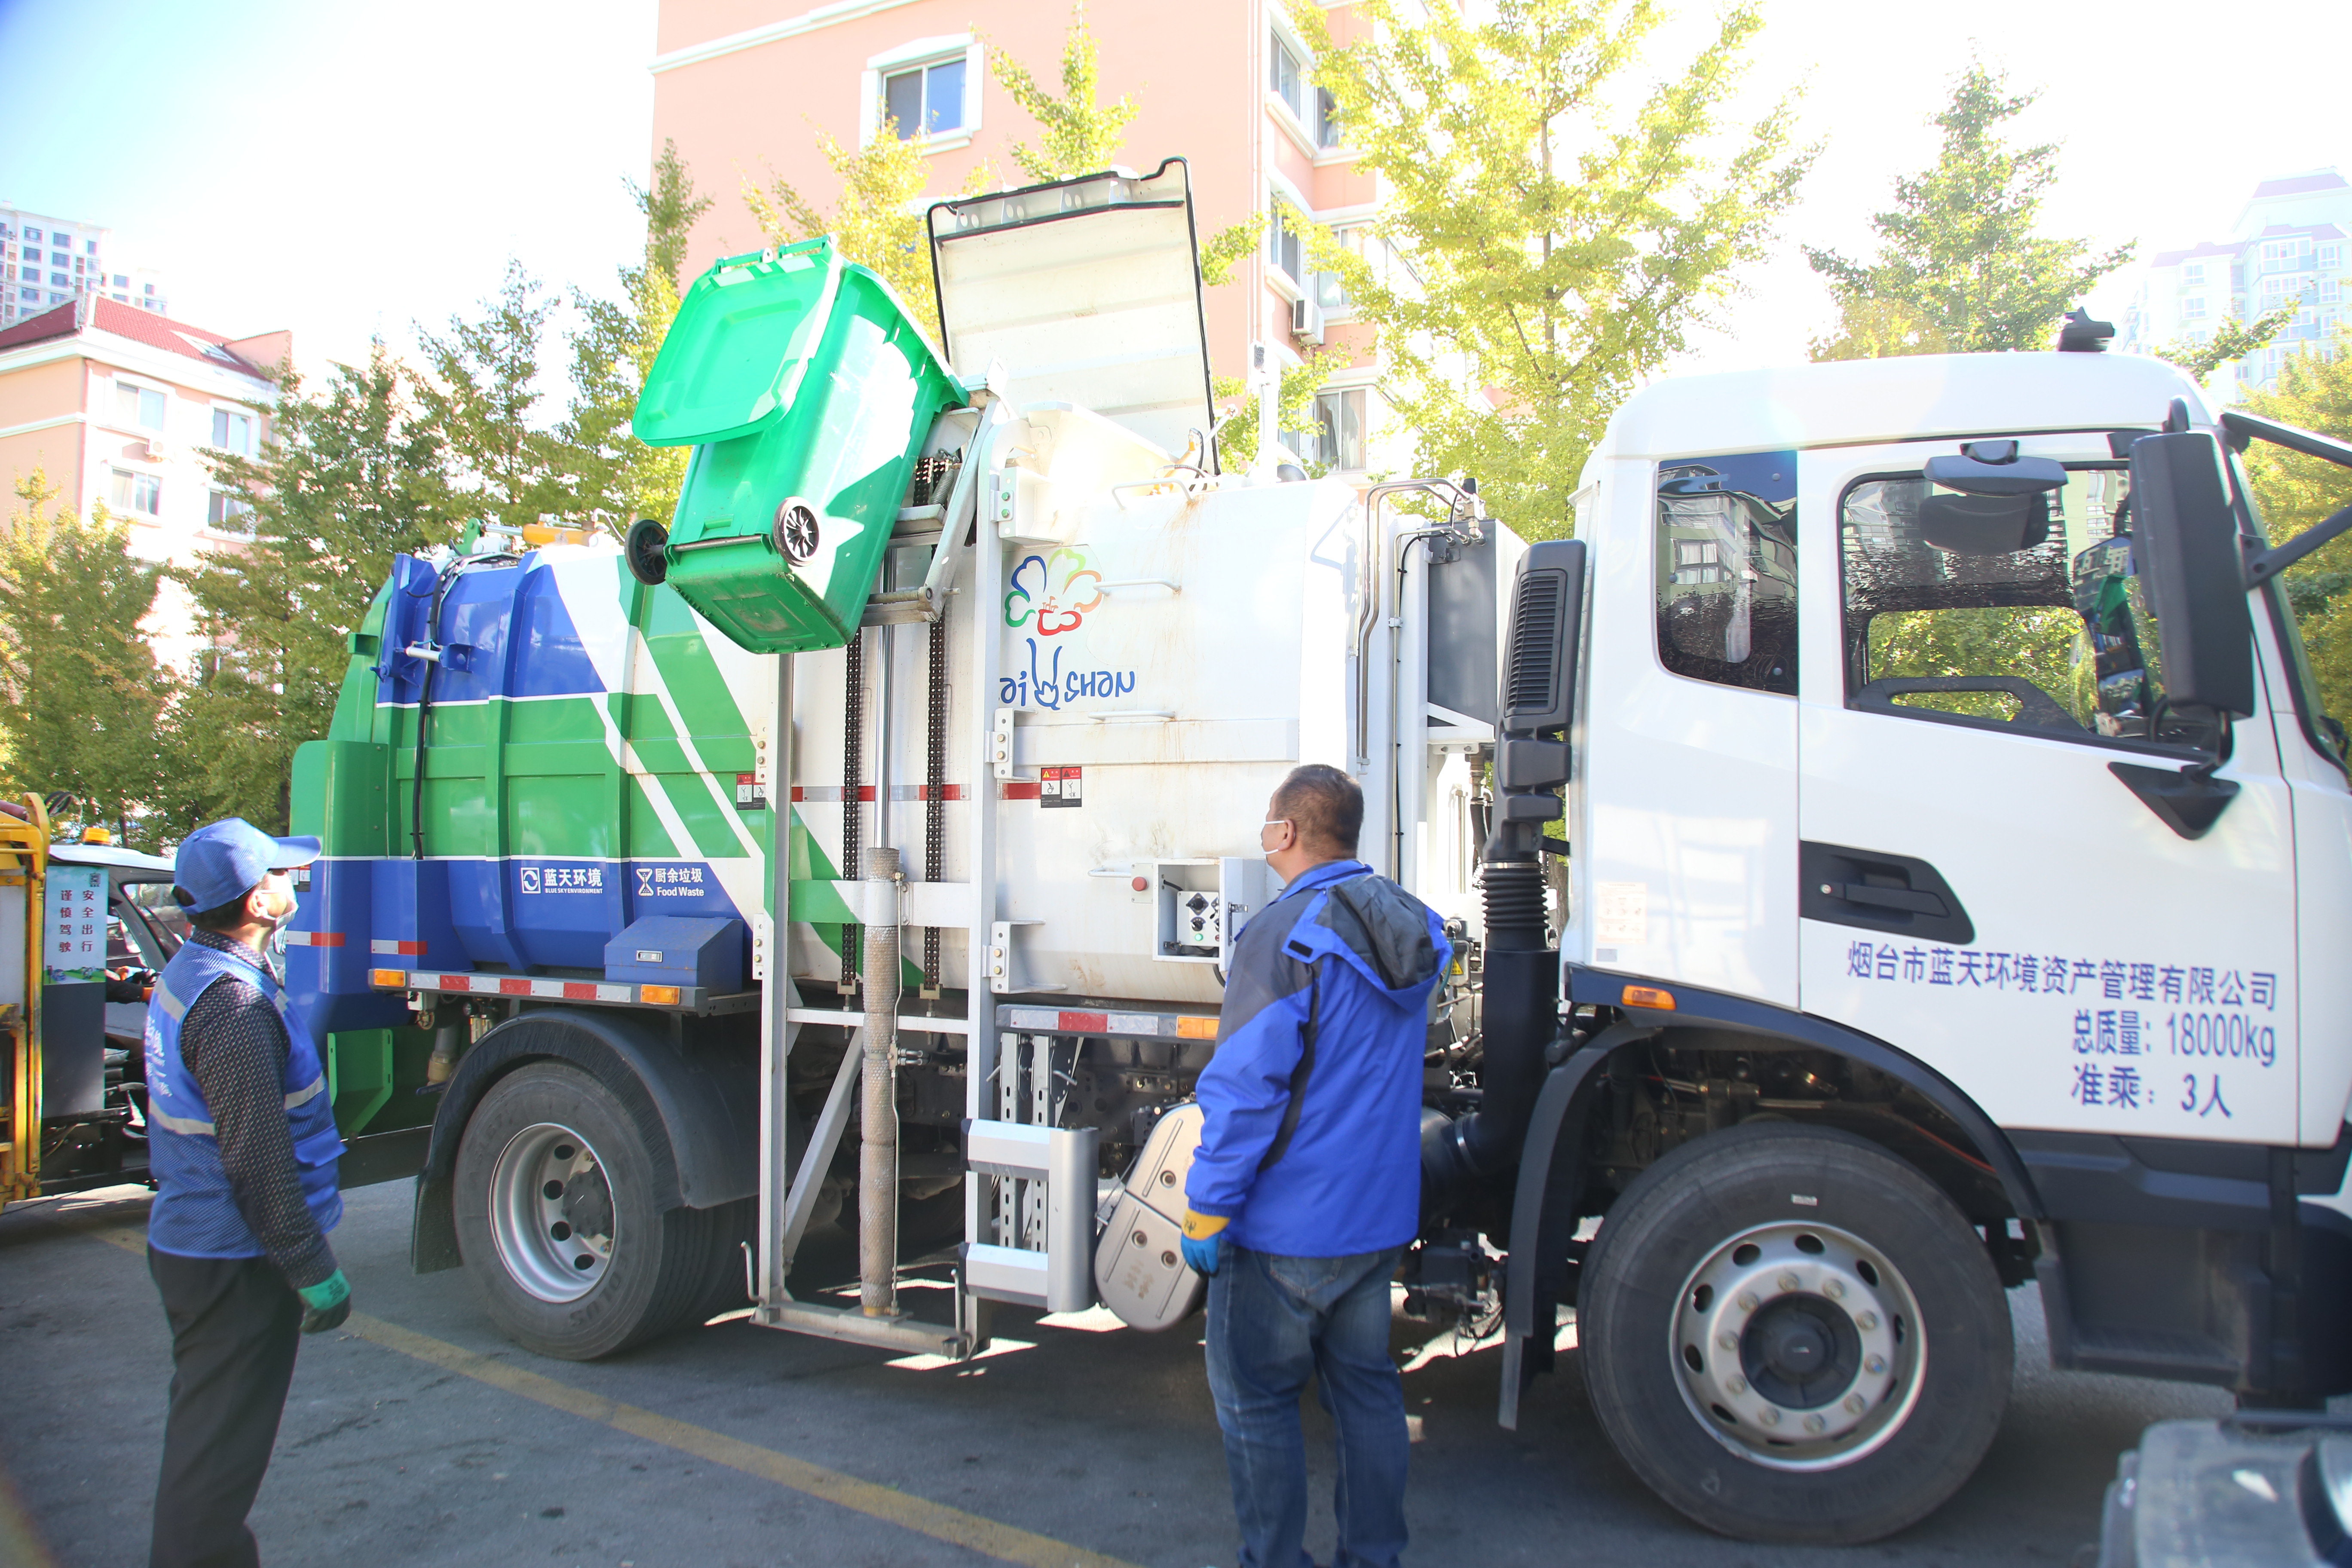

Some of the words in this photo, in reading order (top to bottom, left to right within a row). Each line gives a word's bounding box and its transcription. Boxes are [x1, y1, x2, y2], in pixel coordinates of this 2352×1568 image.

[544, 868, 603, 887] 蓝天环境
[655, 868, 703, 883] 厨余垃圾
[657, 886, 677, 896] Food
[678, 887, 704, 897] Waste
[59, 890, 73, 952] 谨慎驾驶
[81, 890, 95, 952] 安全出行
[1847, 940, 2276, 1011] 烟台市蓝天环境资产管理有限公司
